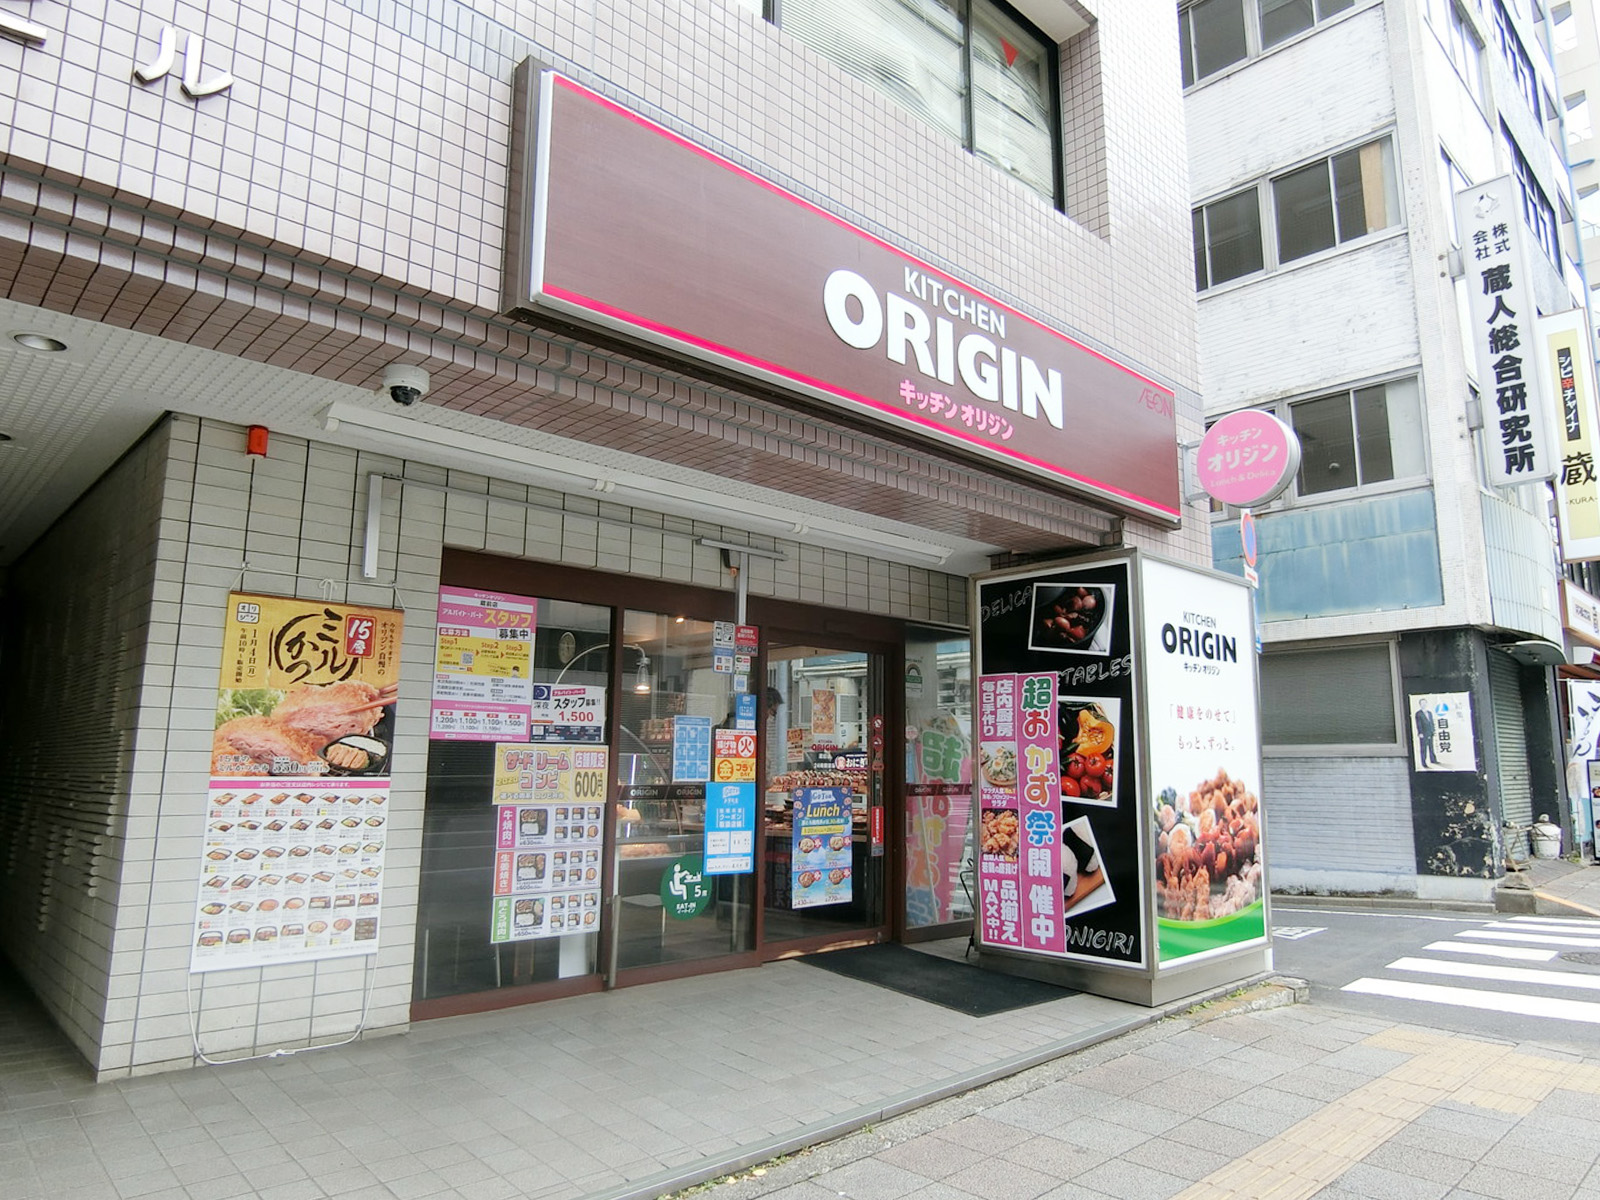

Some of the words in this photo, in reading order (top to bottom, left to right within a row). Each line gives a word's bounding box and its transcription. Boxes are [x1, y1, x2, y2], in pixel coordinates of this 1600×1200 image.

[1473, 231, 1491, 260] 会社
[1492, 223, 1510, 254] 株式
[904, 266, 1005, 339] KITCHEN
[823, 269, 1063, 430] ORIGIN
[1481, 264, 1535, 474] 蔵人総合研究所
[899, 379, 958, 419] キッチン
[961, 405, 1014, 440] オリジン
[1217, 428, 1262, 446] キッチン
[1207, 444, 1278, 472] オリジン
[1561, 452, 1597, 486] 蔵
[484, 609, 532, 627] スタッフ
[499, 628, 528, 640] 募集中
[1183, 611, 1216, 628] KITCHEN
[1161, 623, 1237, 663] ORIGIN
[559, 711, 594, 722] 1,500
[982, 681, 995, 736] 毎日手作り
[996, 679, 1014, 737] 店内厨房
[740, 739, 752, 753] 火
[1438, 718, 1452, 753] 自由党
[806, 804, 840, 818] Lunch
[1021, 676, 1060, 945] 超おかず祭開催中
[1001, 880, 1018, 942] 品揃え
